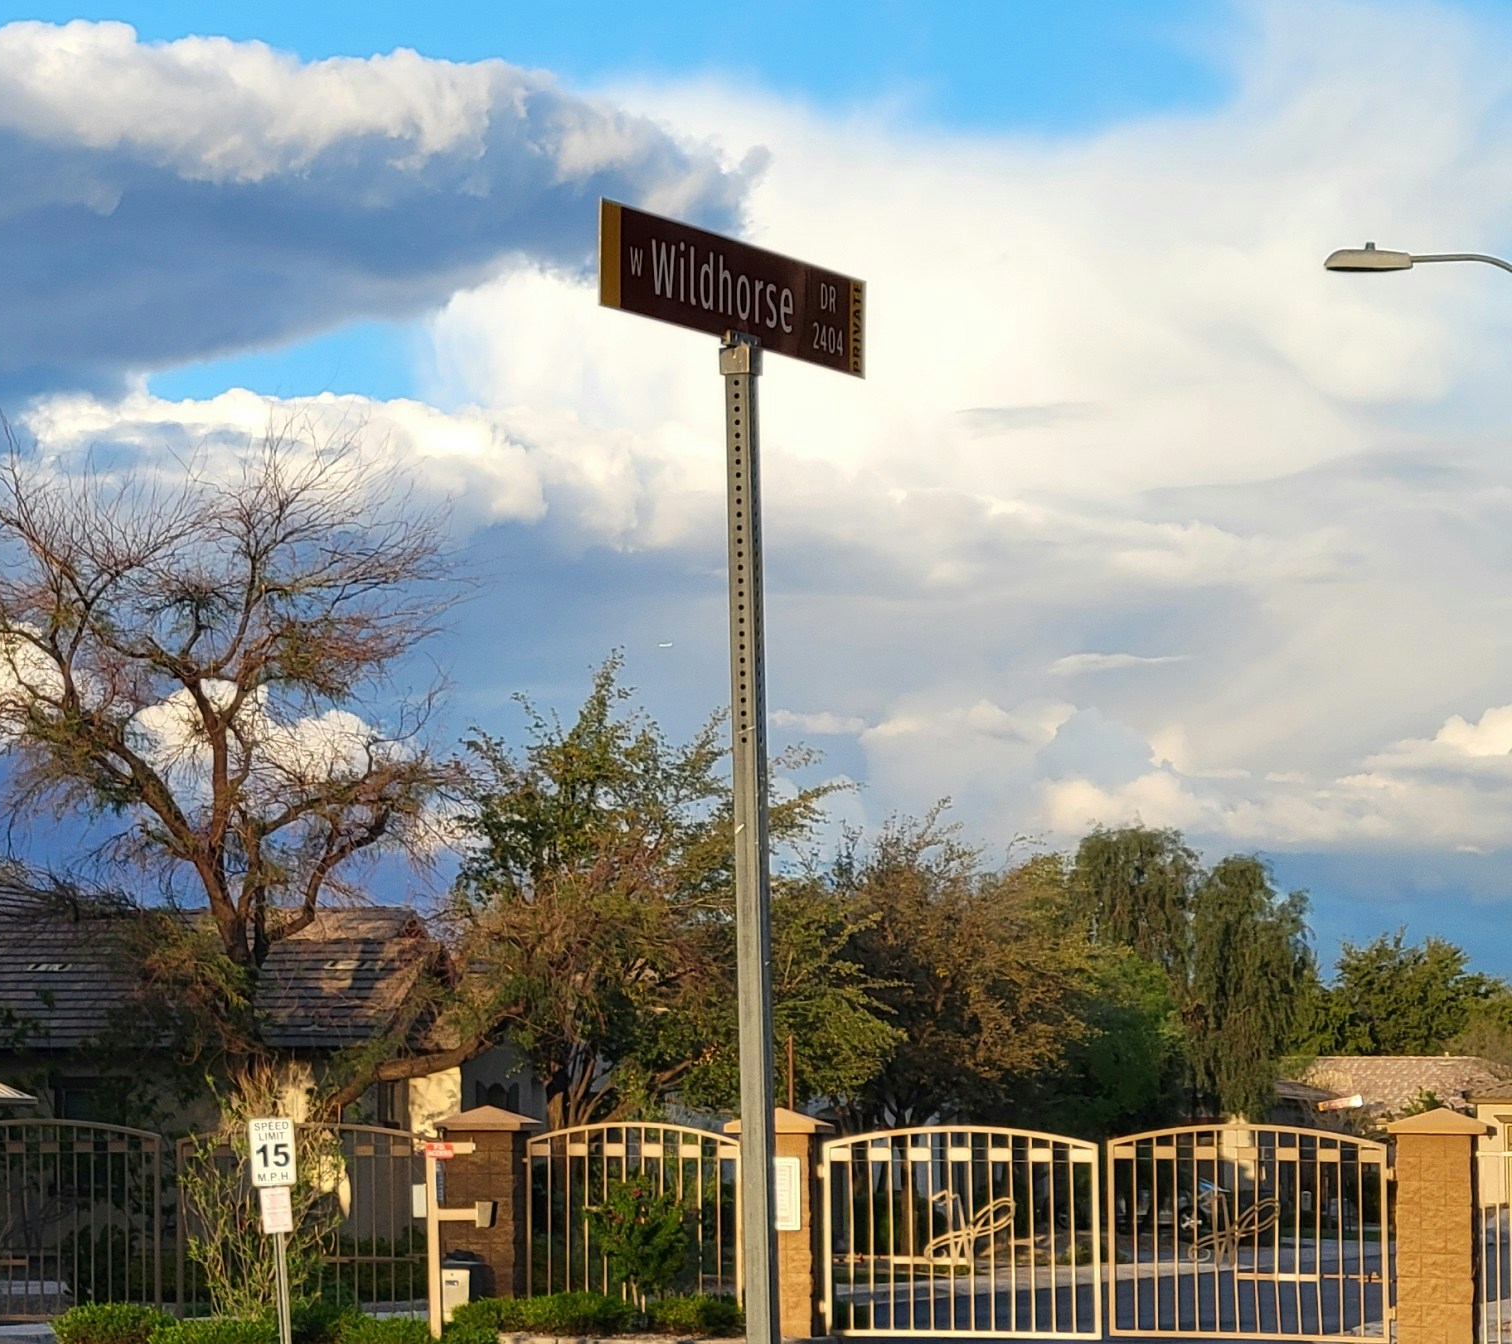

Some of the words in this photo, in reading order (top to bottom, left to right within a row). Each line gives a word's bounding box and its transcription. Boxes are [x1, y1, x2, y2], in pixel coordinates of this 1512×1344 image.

[629, 245, 643, 277] W
[651, 238, 794, 334] Wildhorse
[820, 282, 837, 315] DR
[812, 321, 844, 357] 2404
[852, 281, 863, 373] PRIVATE
[254, 1121, 289, 1131] SPEED
[258, 1132, 285, 1142] LIMIT
[255, 1143, 291, 1168] 15
[257, 1172, 292, 1182] M.P.H.
